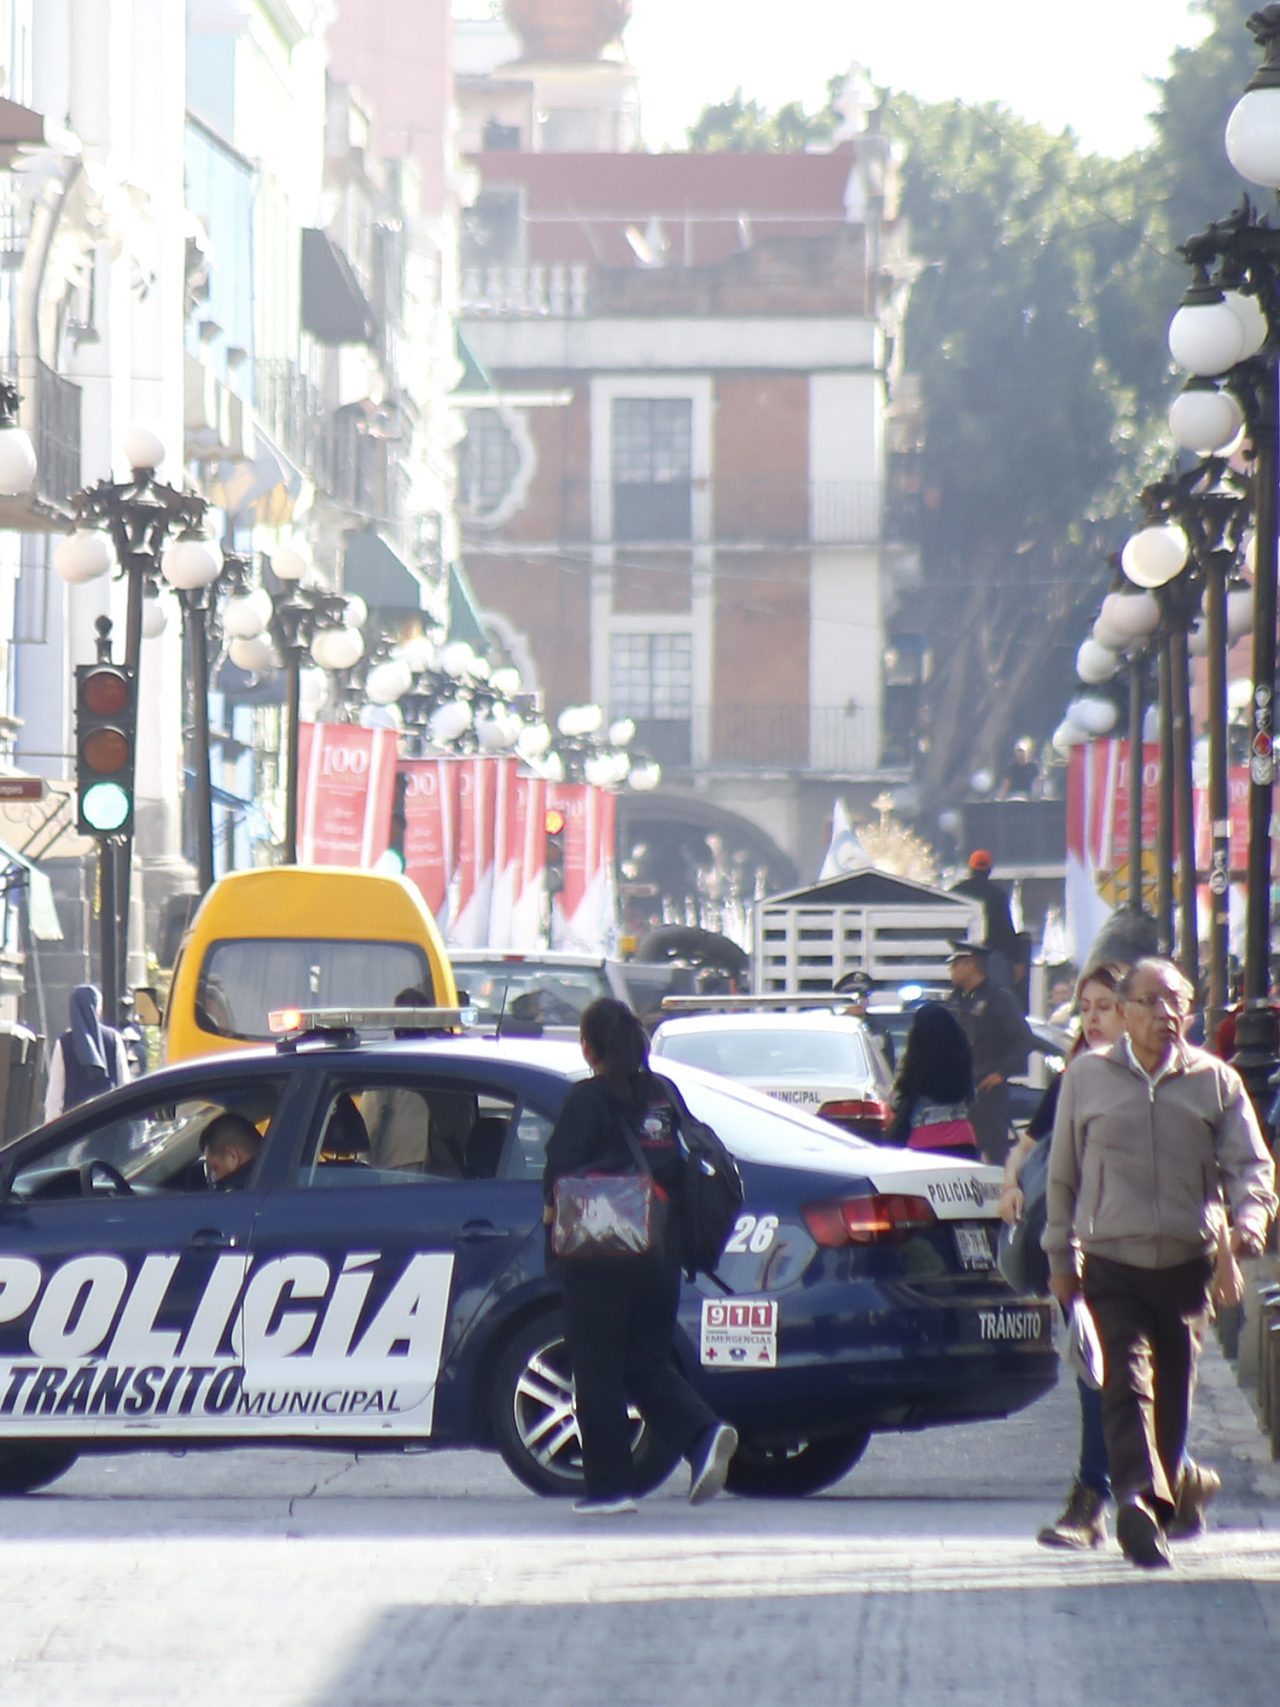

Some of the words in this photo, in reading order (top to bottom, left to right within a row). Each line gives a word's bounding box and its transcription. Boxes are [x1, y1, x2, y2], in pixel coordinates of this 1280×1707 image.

[323, 745, 368, 775] 100
[405, 773, 436, 796] 00
[1119, 761, 1160, 788] 10
[926, 1177, 973, 1203] POLICÍA
[724, 1214, 779, 1254] 26
[710, 1307, 766, 1326] 911
[978, 1306, 1041, 1339] TRÁNSITO
[705, 1335, 772, 1345] EMERGENCIAS
[0, 1358, 246, 1416] TRÁNSITO
[239, 1389, 402, 1416] MUNICIPAL
